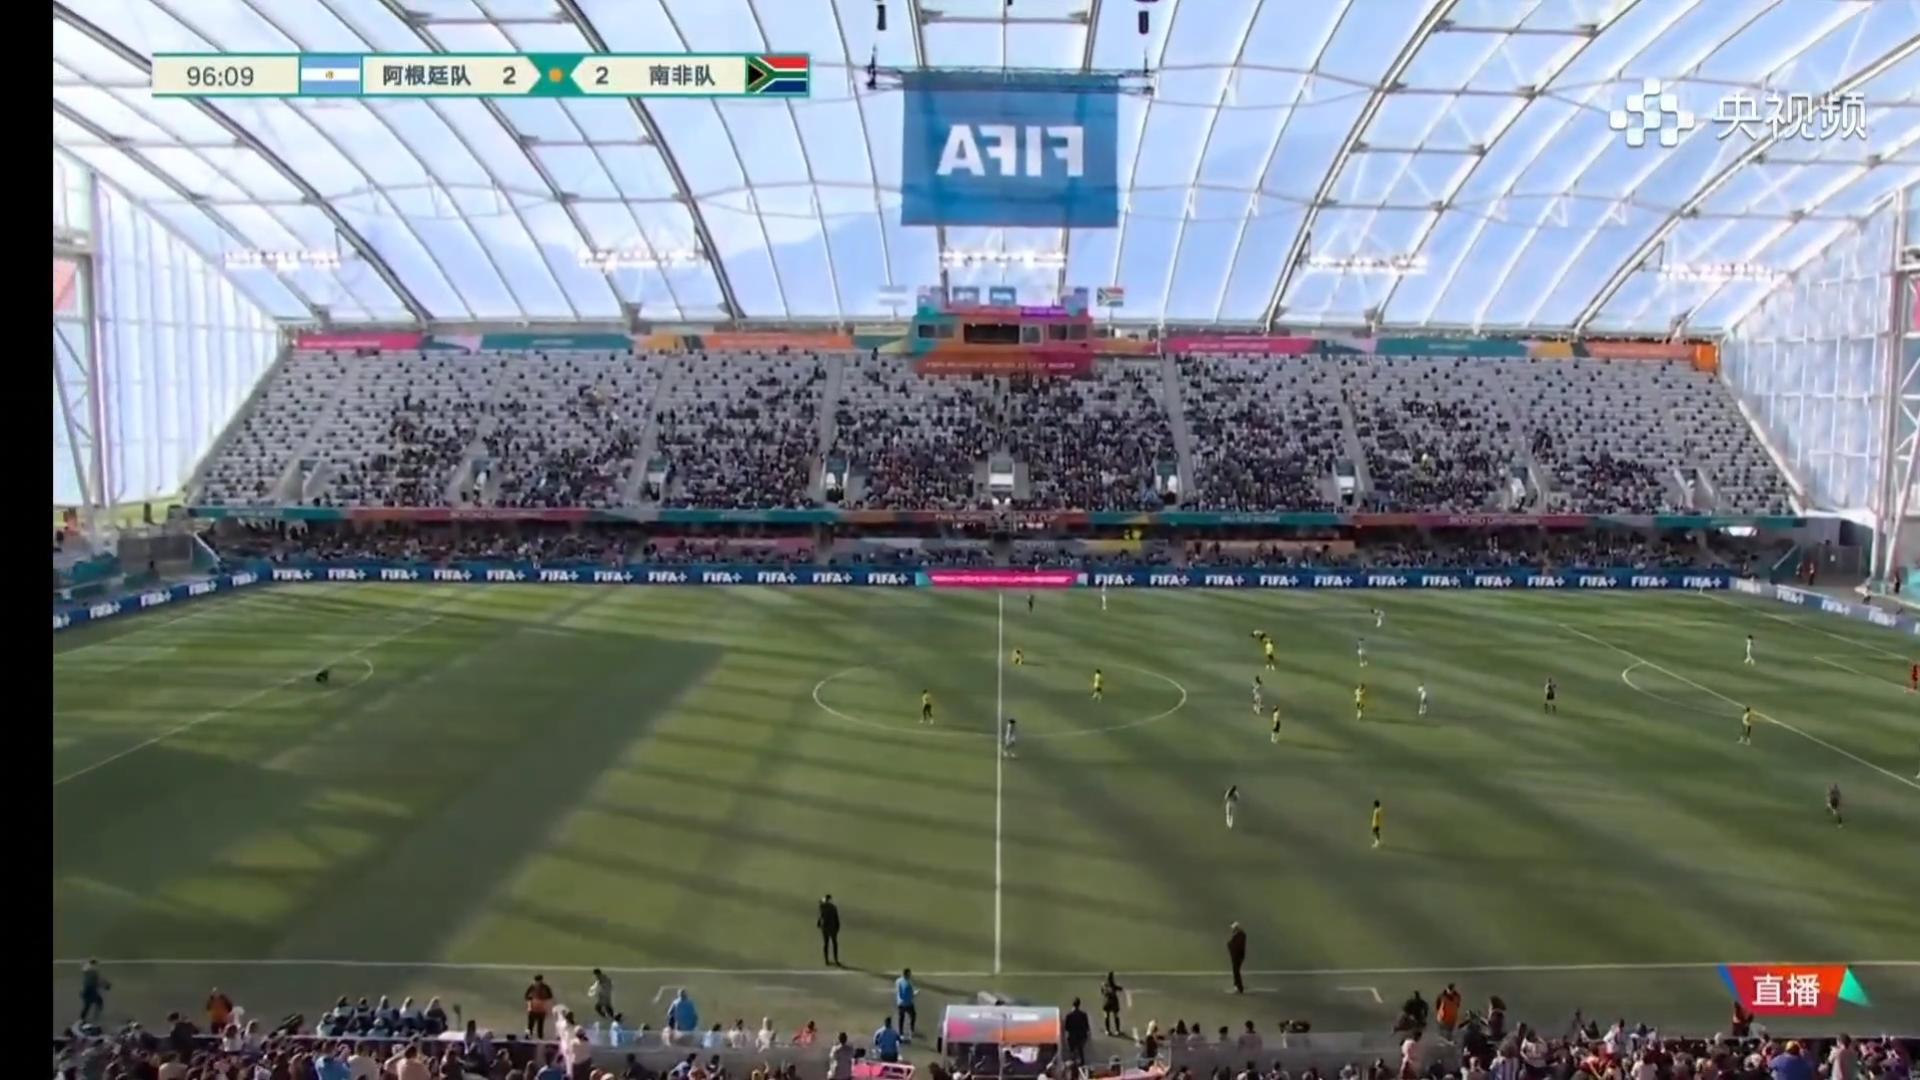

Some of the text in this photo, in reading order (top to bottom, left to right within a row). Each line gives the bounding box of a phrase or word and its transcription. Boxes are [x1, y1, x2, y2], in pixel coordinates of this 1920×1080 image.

[273, 569, 312, 581] FIFA+
[327, 569, 366, 581] FIFA+
[381, 569, 418, 581] FIFA+
[434, 569, 472, 581] FIFA+
[487, 570, 525, 581] FIFA+
[541, 570, 579, 581] FIFA+
[595, 571, 633, 582] FIFA+
[649, 571, 687, 582] FIFA+
[703, 571, 741, 582] FIFA+
[758, 572, 796, 583] FIFA+
[813, 572, 852, 583] FIFA+
[868, 573, 908, 584] FIFA+
[1095, 574, 1134, 585] FIFA+
[1150, 574, 1189, 585] FIFA+
[1205, 574, 1244, 585] FIFA+
[1260, 575, 1299, 586] FIFA+
[1314, 576, 1353, 587] FIFA+
[1368, 576, 1407, 587] FIFA+
[1422, 576, 1460, 587] FIFA+
[1475, 576, 1513, 587] FIFA+
[1528, 576, 1565, 587] FIFA+
[1580, 576, 1618, 587] FIFA+
[1632, 576, 1670, 588] FIFA+
[1684, 576, 1722, 588] FIFA+
